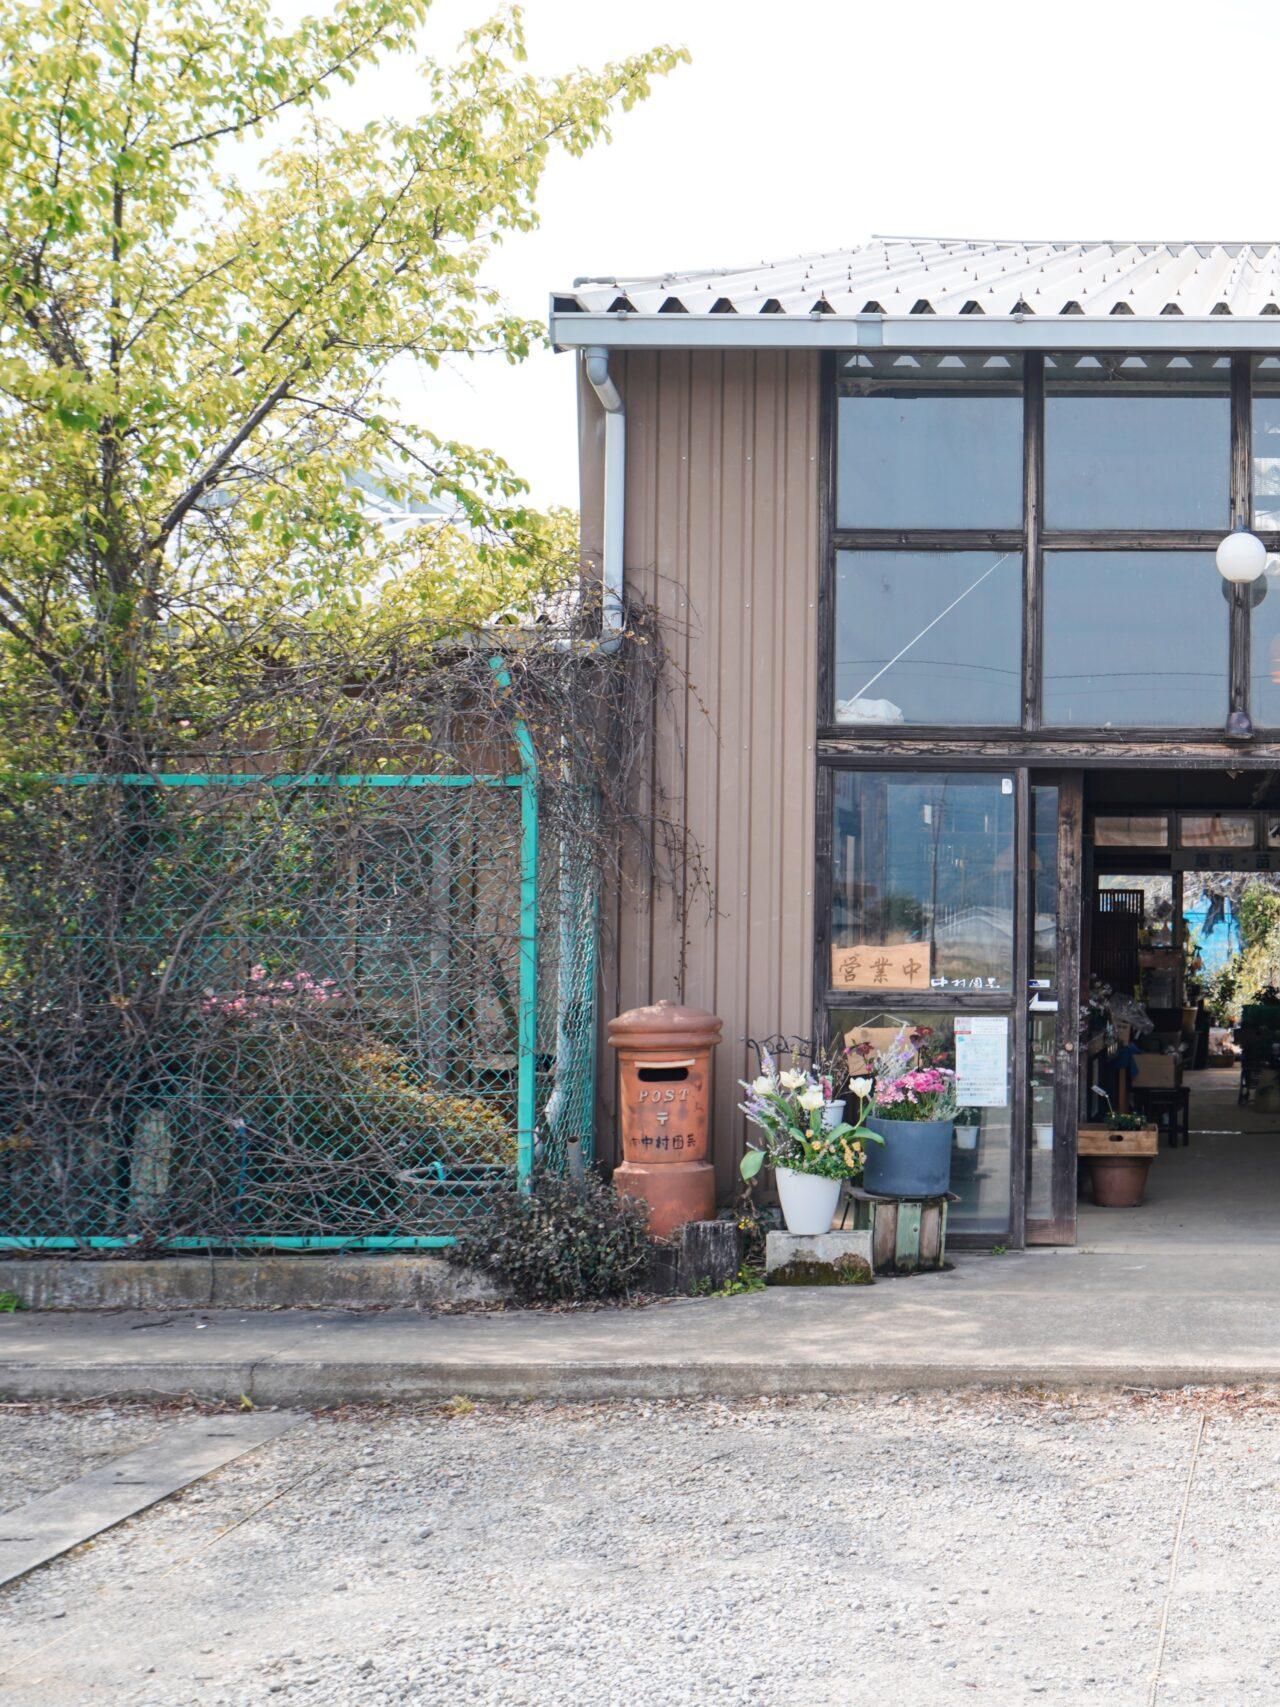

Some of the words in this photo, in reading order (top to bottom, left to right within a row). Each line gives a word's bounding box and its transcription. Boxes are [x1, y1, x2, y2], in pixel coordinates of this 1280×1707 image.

[840, 955, 922, 984] 営業中
[639, 1090, 689, 1104] POST
